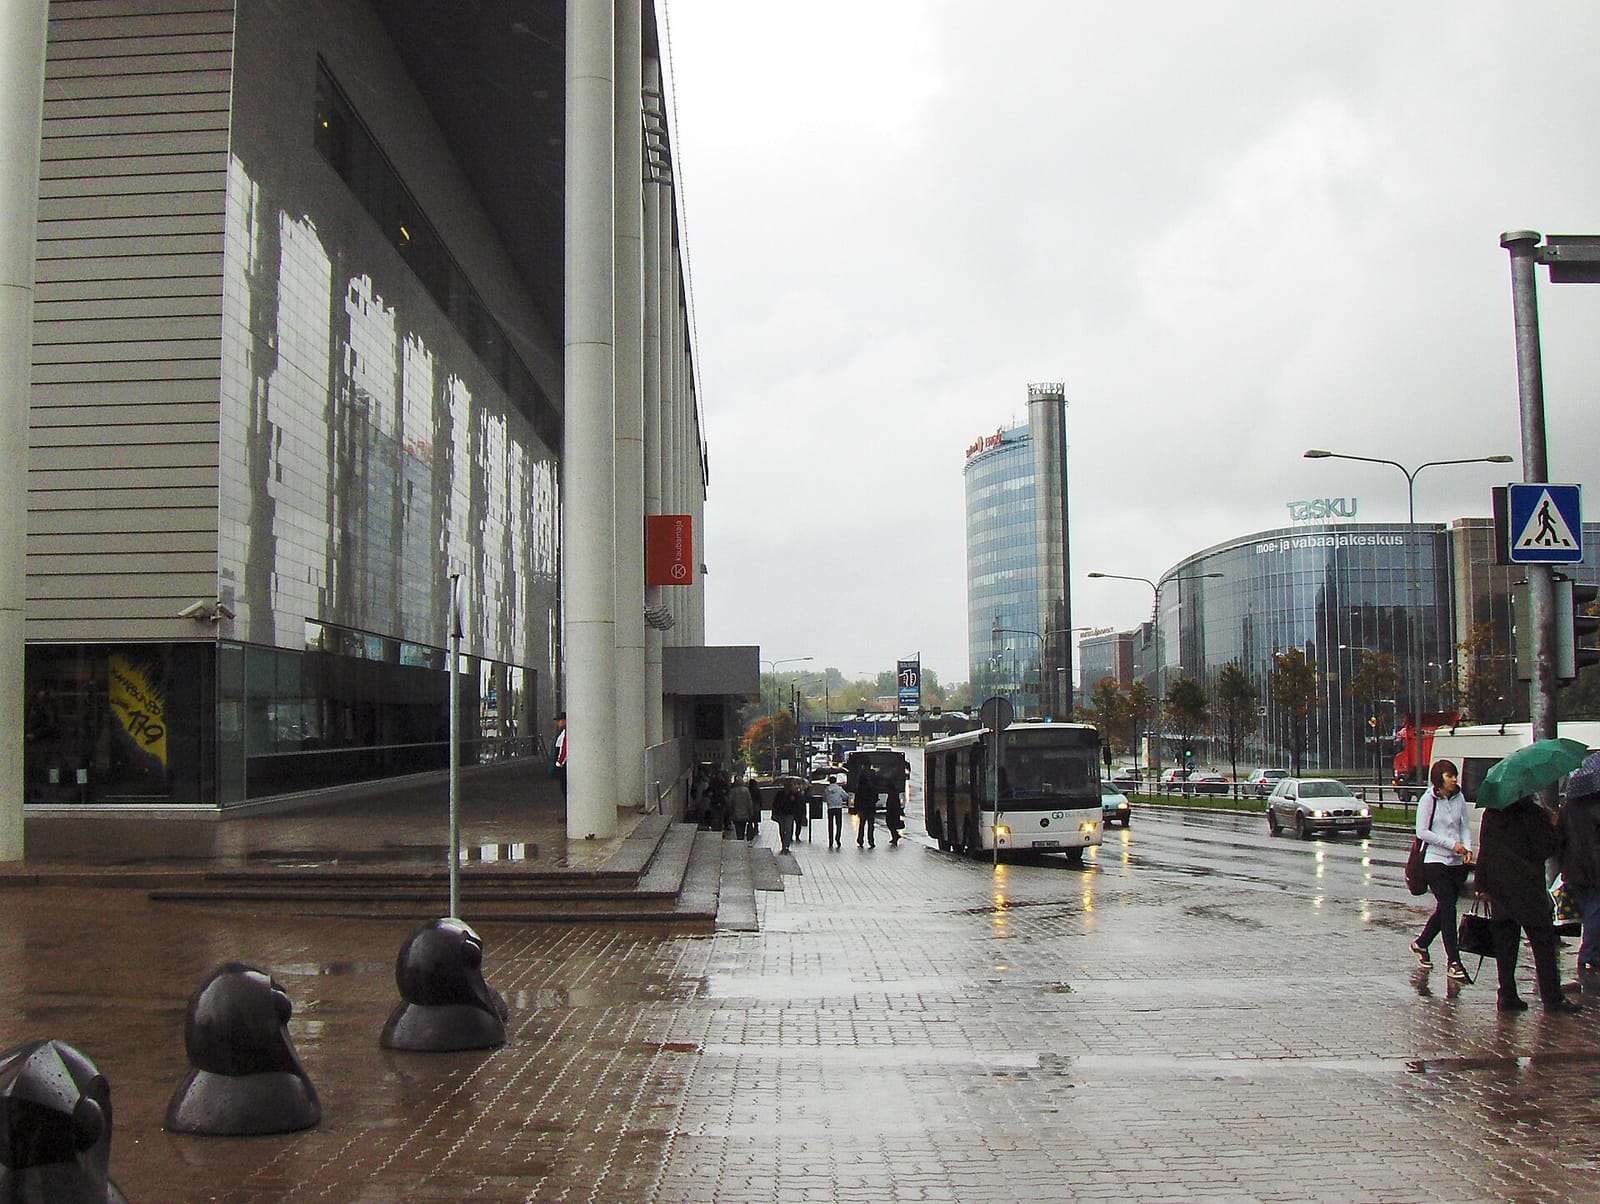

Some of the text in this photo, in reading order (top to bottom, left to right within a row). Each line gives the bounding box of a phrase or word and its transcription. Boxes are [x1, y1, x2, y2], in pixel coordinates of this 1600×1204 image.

[675, 520, 684, 562] kaubamaja
[1256, 533, 1404, 555] moe- ja vabaajakeskus
[1008, 734, 1017, 745] 4
